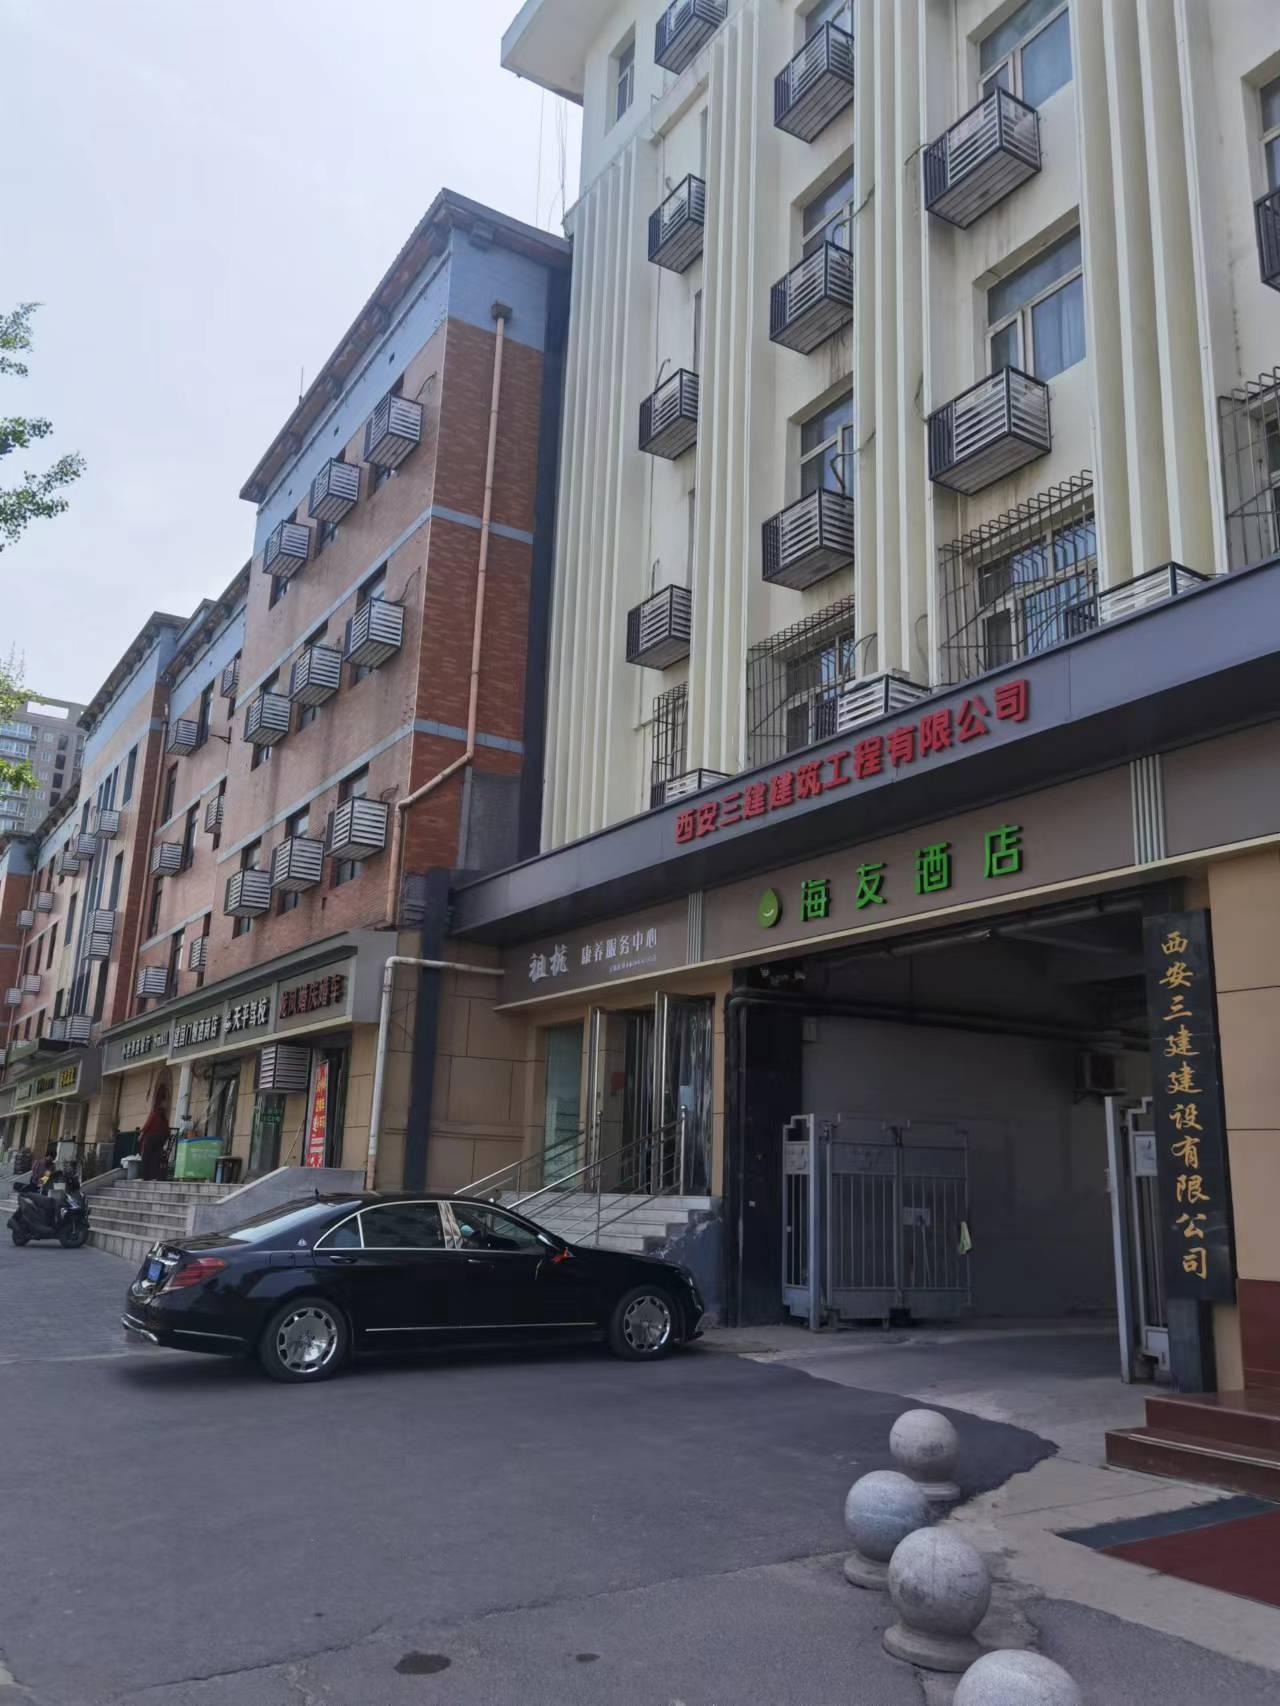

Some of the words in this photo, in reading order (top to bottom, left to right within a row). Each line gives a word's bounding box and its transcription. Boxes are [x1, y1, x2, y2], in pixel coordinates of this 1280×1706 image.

[675, 679, 1029, 843] 西安三建建筑工程有限公司
[800, 824, 1023, 922] 海友酒店
[581, 928, 657, 966] 康养服务中心
[231, 997, 268, 1032] 天平驾校
[1159, 930, 1211, 1281] 西安三建建设有限公司
